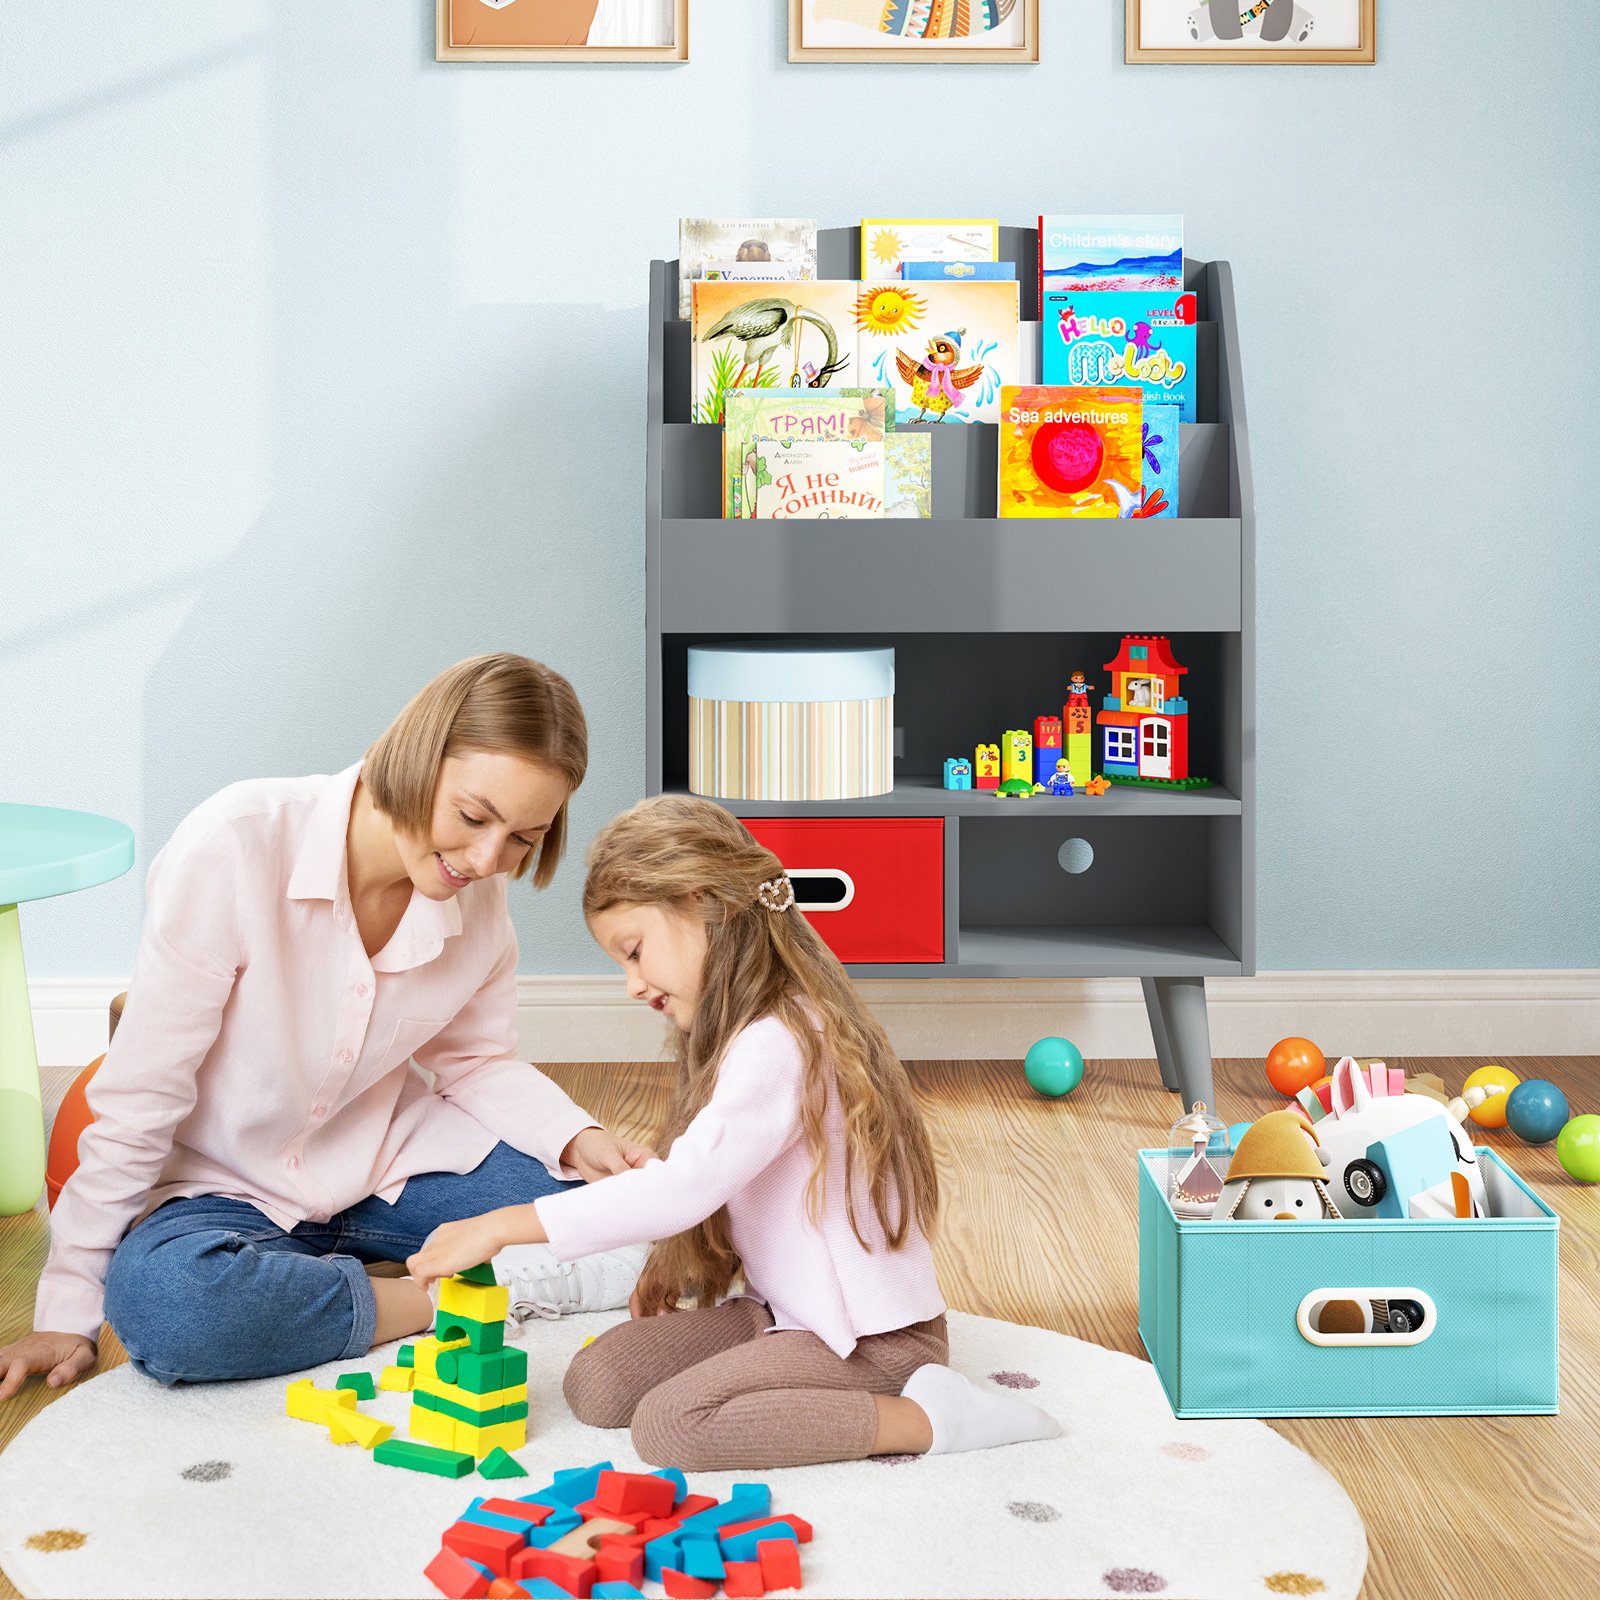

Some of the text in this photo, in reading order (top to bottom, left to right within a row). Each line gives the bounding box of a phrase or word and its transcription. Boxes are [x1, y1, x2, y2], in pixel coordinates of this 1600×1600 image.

[1050, 233, 1175, 251] Children's story
[1146, 303, 1184, 318] LEVEL 1
[1059, 317, 1124, 343] HELLO
[1163, 392, 1186, 401] Book
[1009, 407, 1129, 424] Sea adventures
[770, 412, 845, 434] ТРЯМ!
[775, 473, 839, 500] Я не
[1076, 721, 1084, 733] 5
[1046, 736, 1055, 747] 4
[1018, 750, 1026, 761] 3
[984, 764, 993, 776] 2
[956, 778, 963, 789] 1
